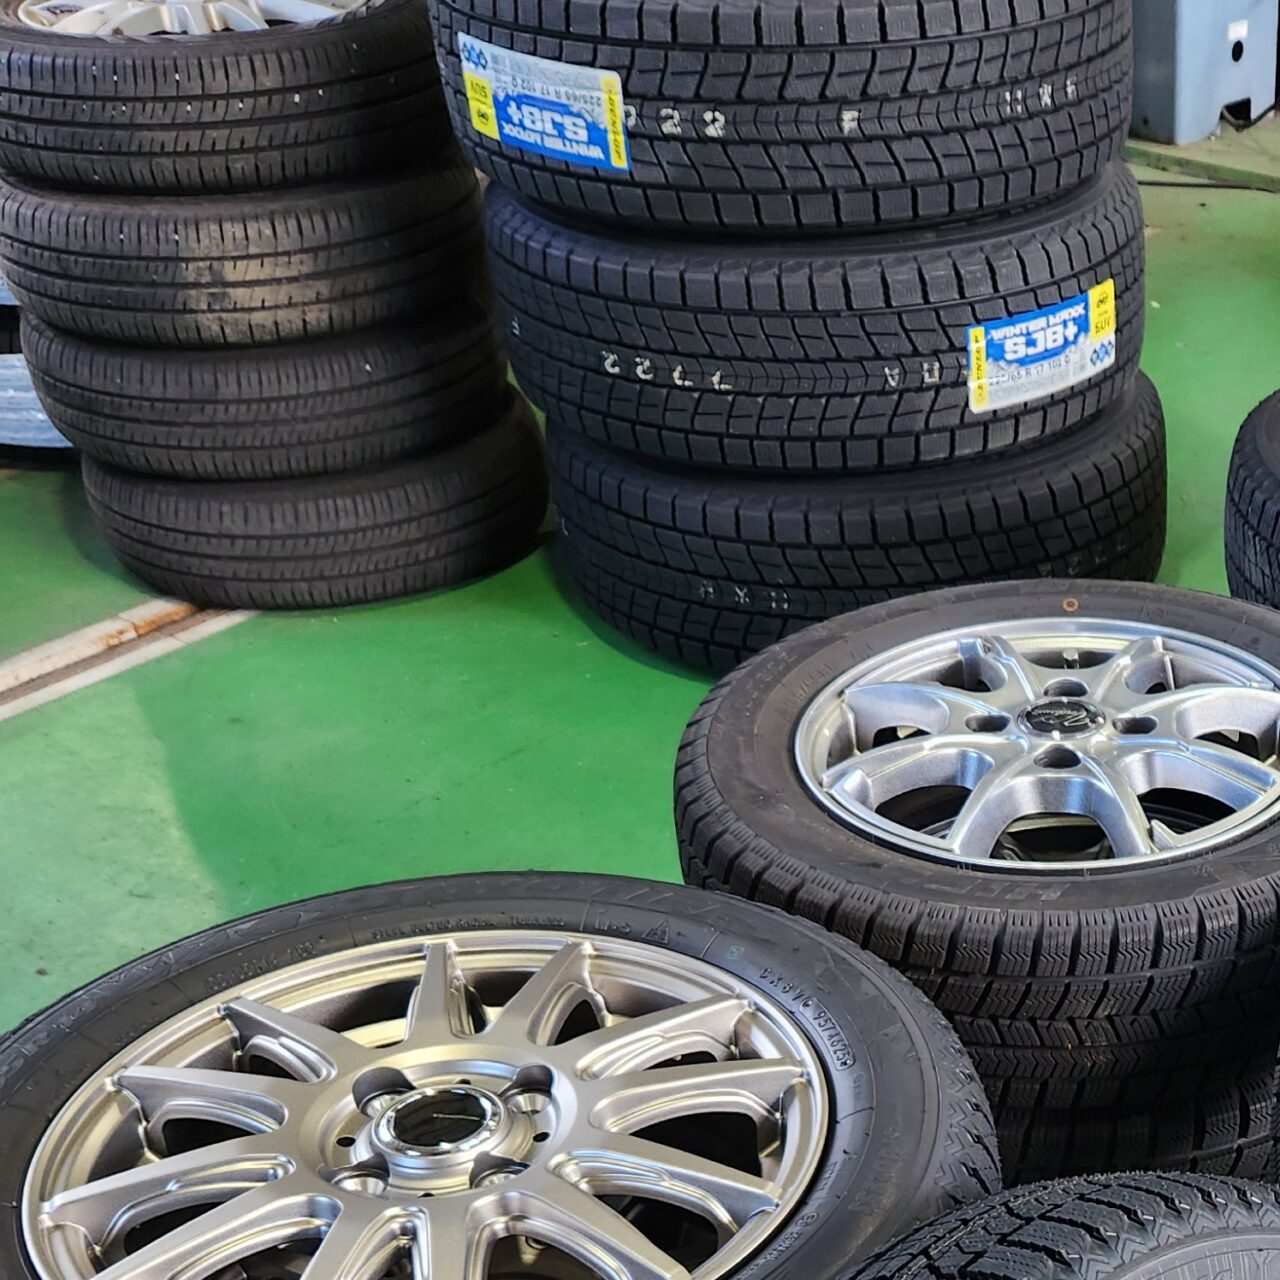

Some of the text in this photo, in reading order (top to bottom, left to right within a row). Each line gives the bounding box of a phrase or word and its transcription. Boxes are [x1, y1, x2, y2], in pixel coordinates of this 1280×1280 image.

[543, 135, 606, 160] WINTER
[988, 316, 1047, 341] WINTER
[1095, 315, 1112, 333] SUV
